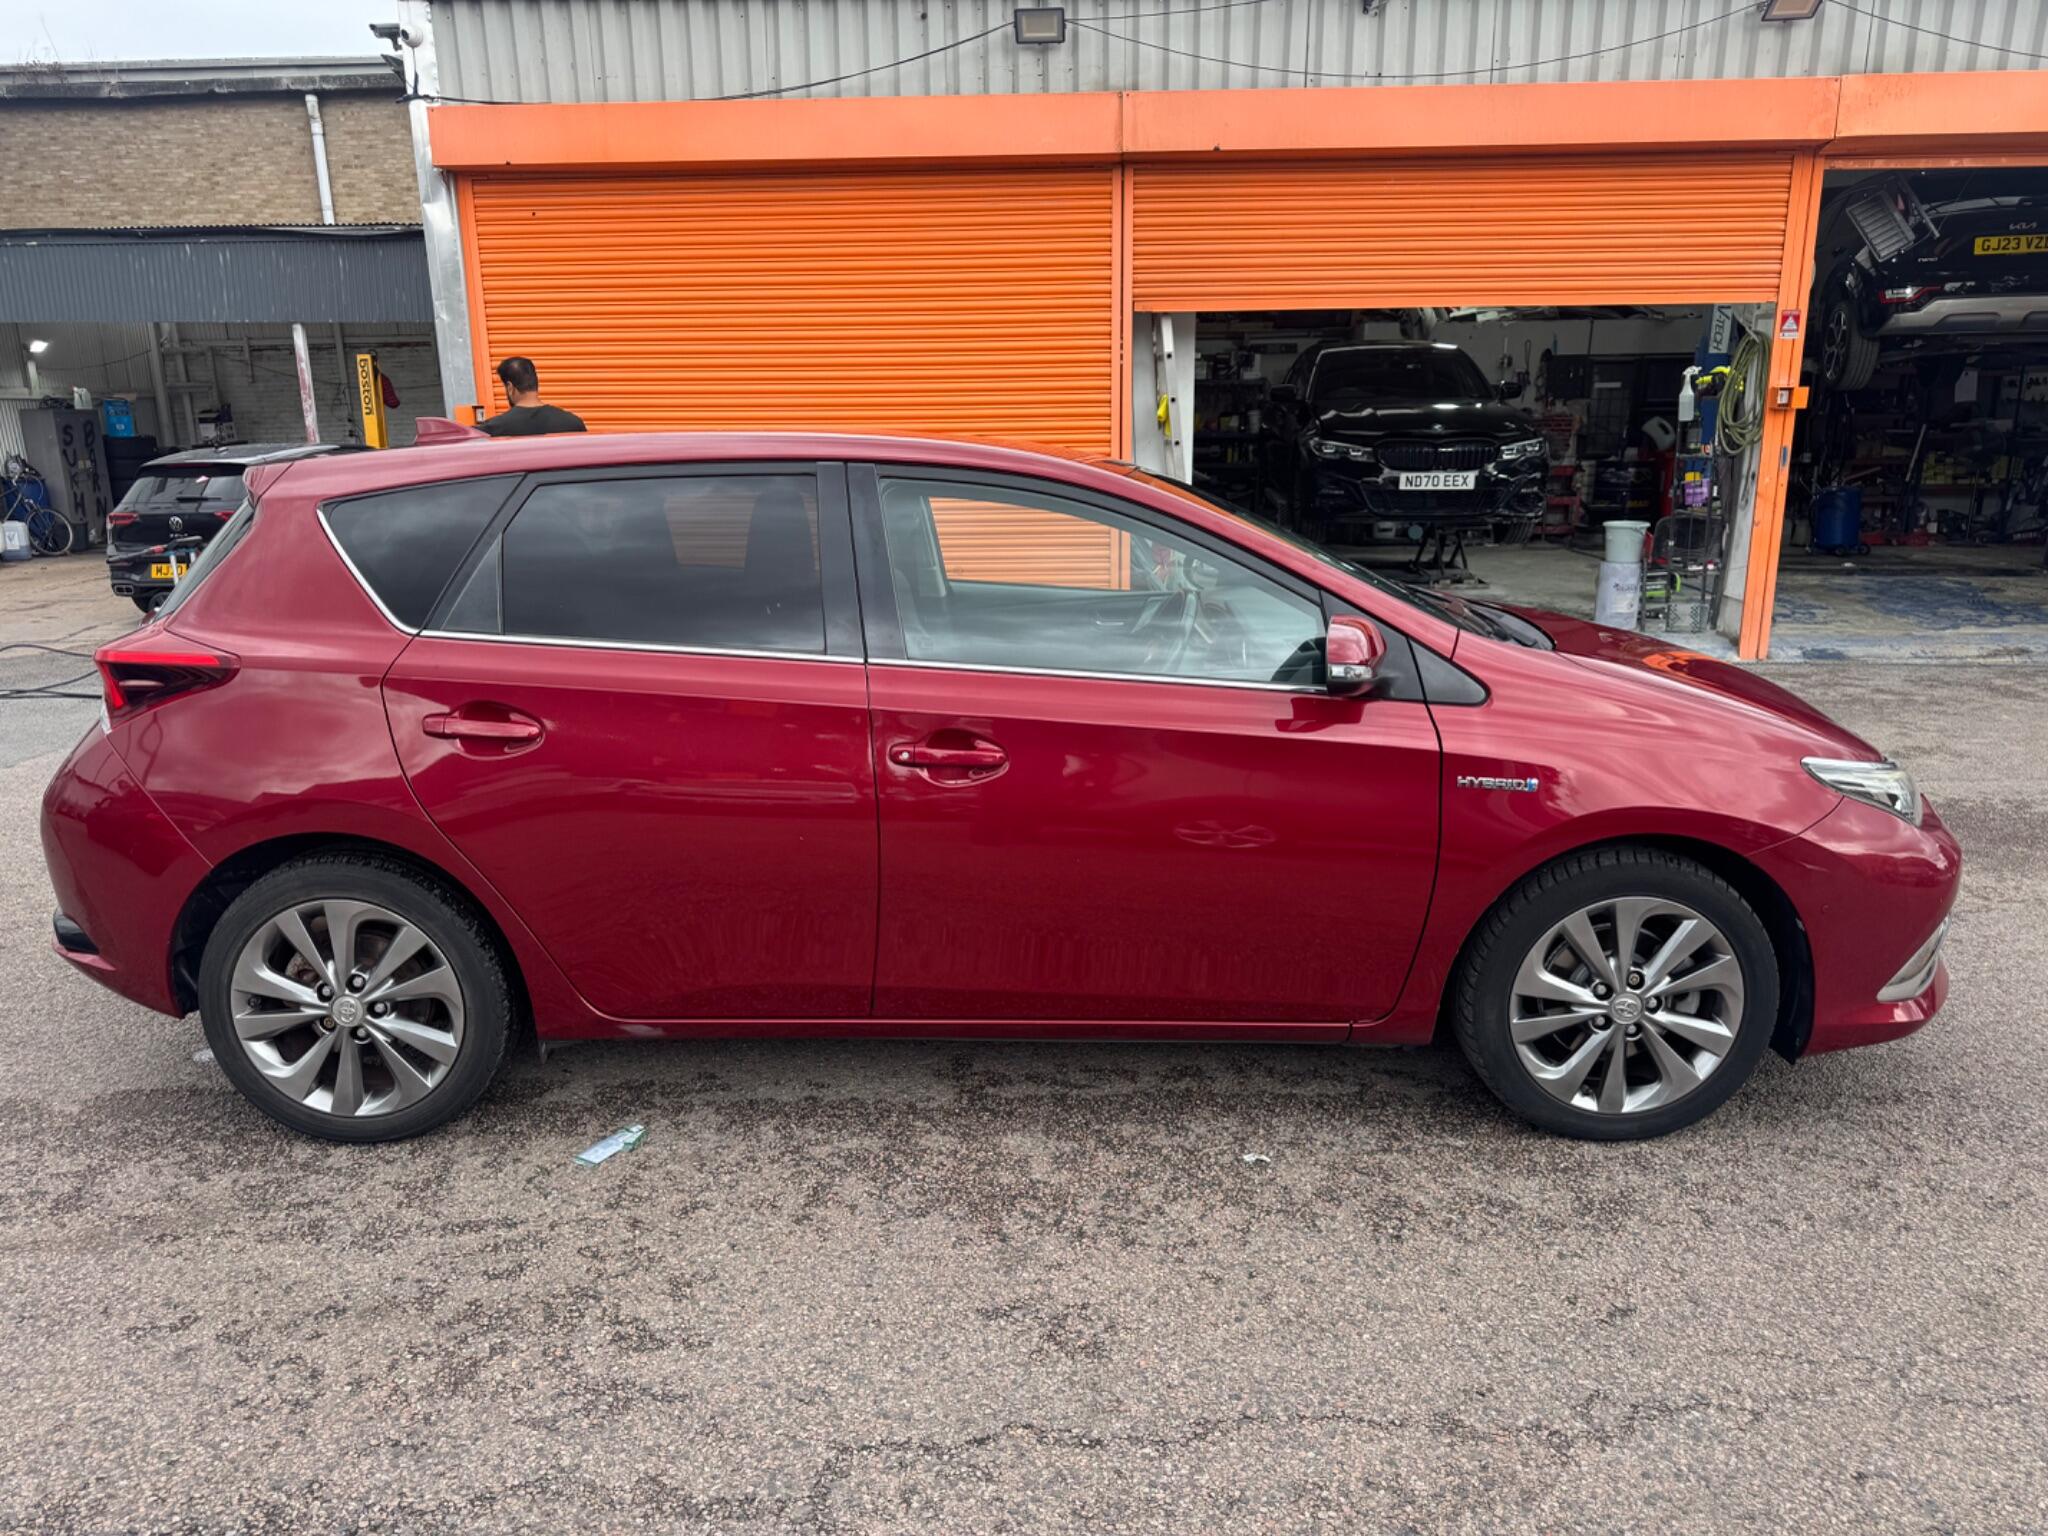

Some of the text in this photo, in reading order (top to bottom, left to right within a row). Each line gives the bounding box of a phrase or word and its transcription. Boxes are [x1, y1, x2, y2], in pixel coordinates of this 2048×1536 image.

[1981, 238, 2020, 251] GJ23
[1712, 305, 1732, 351] V-TECH
[1405, 475, 1469, 487] ND70 EEX
[155, 565, 183, 577] MJ0
[1457, 776, 1526, 791] HYBRID
